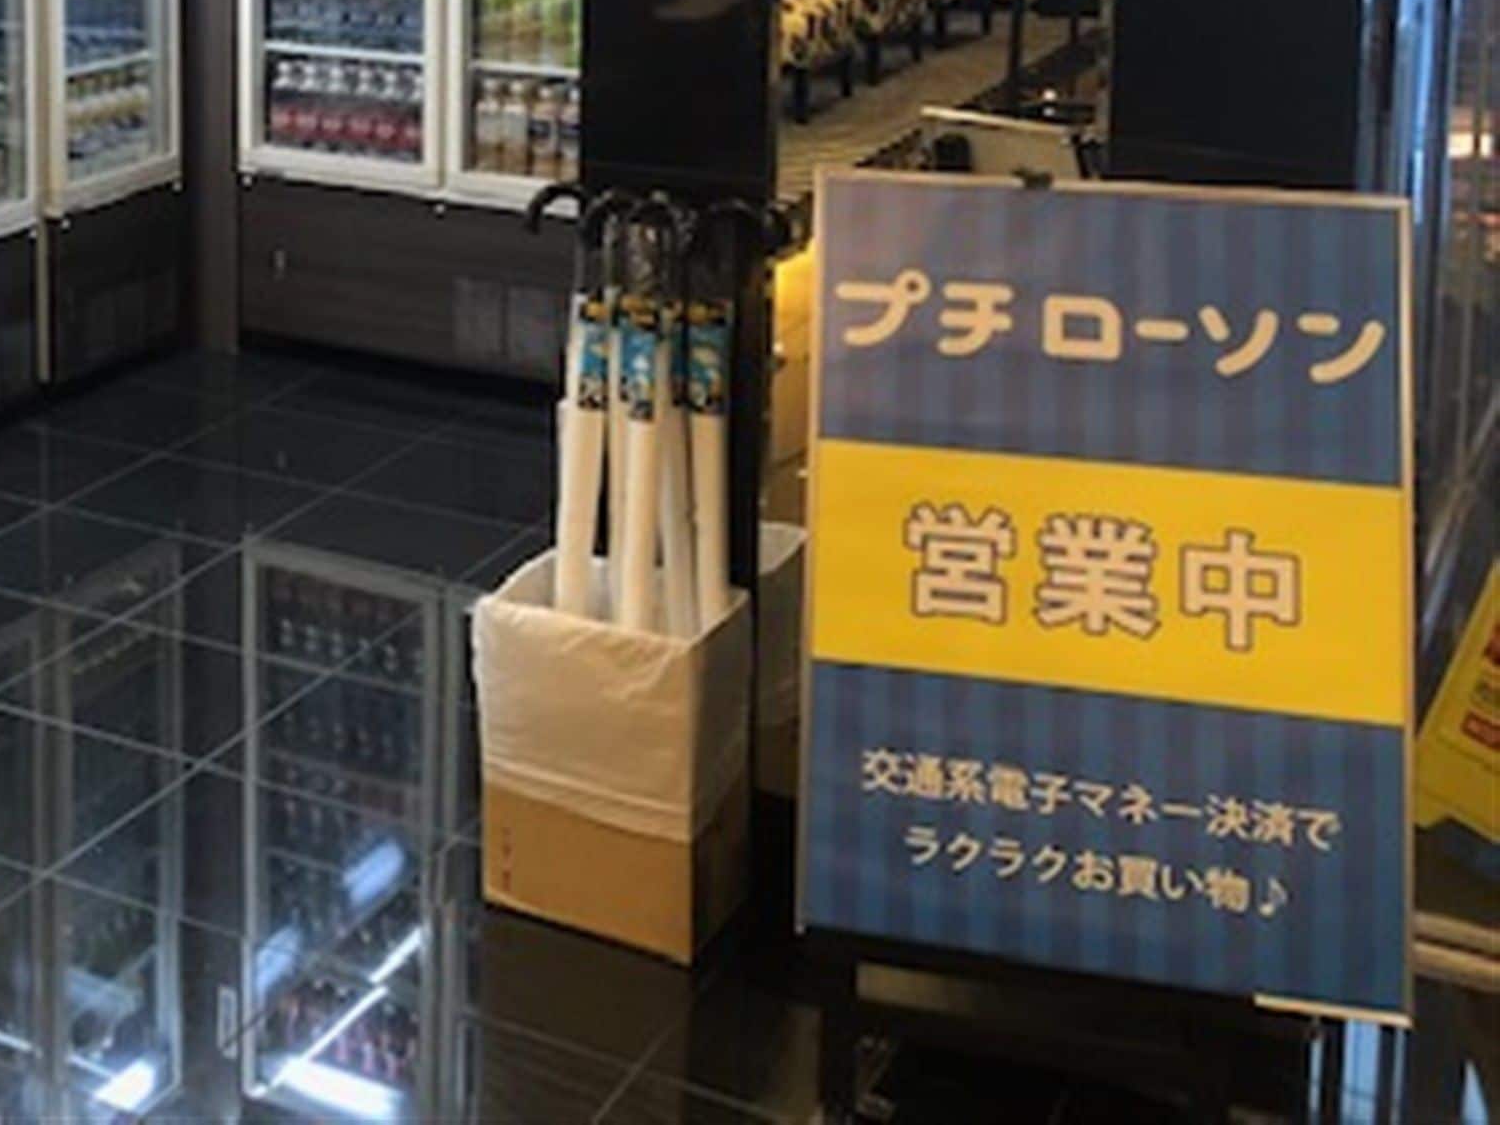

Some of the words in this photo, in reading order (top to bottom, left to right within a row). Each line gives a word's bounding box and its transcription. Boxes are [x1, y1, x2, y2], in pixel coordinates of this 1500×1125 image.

[835, 271, 1386, 383] プチローソン
[905, 501, 1301, 653] 営業中
[861, 749, 1341, 851] 交通系電子マネー決済で
